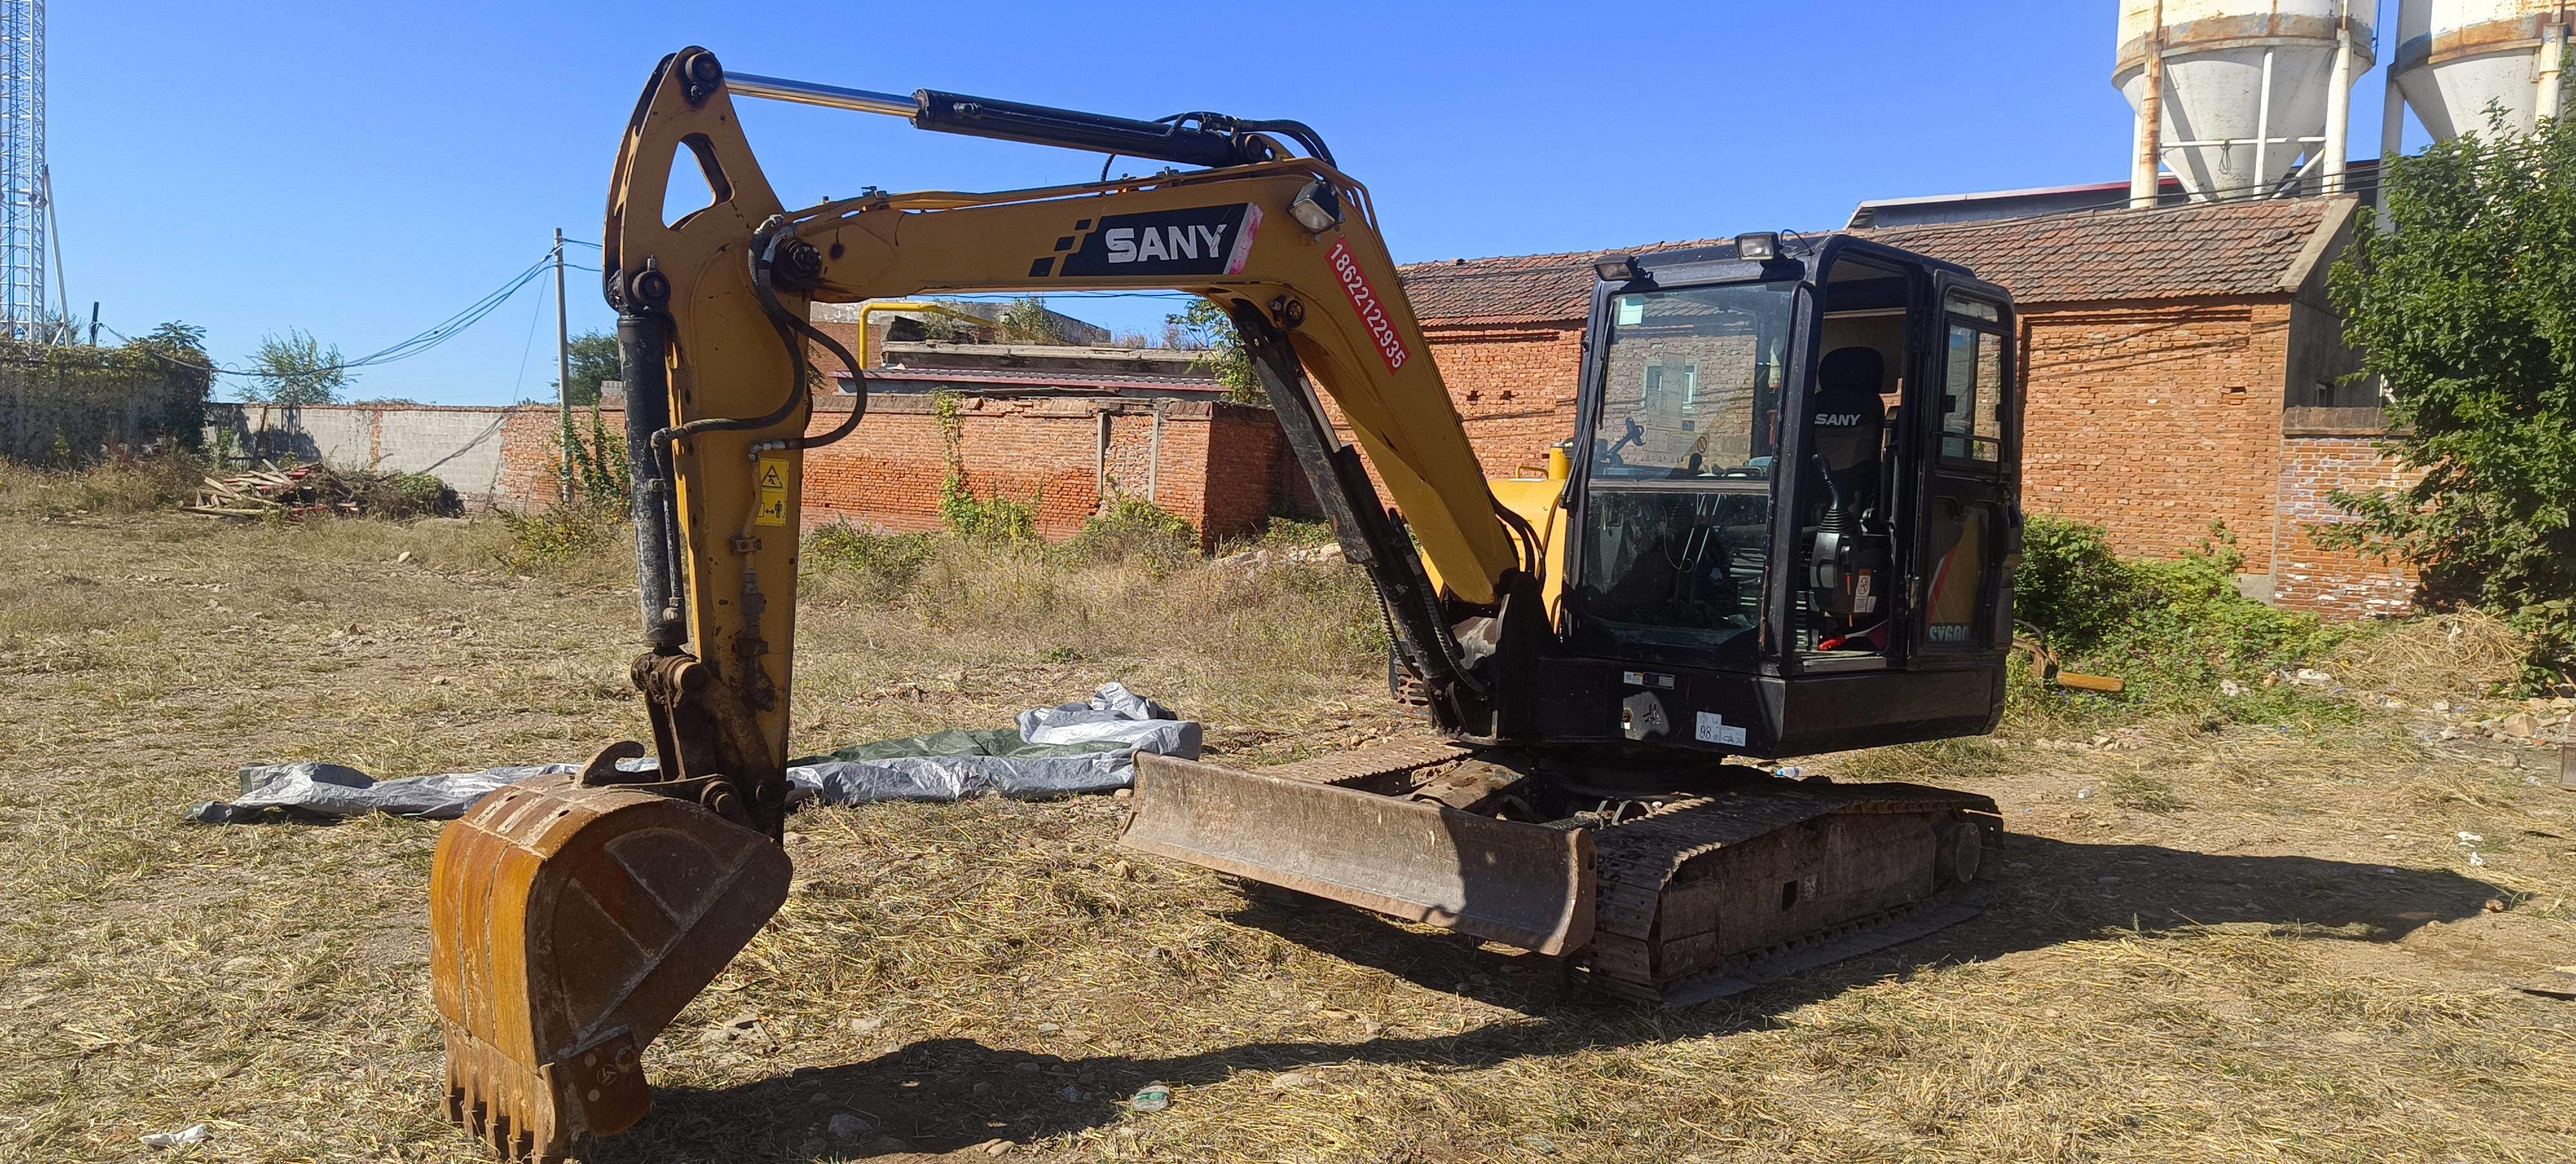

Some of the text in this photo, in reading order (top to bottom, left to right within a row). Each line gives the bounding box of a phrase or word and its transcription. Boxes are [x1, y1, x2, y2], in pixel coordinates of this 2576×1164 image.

[1105, 224, 1227, 263] SANY
[1331, 243, 1406, 368] 18622122935
[1814, 413, 1861, 426] SANY
